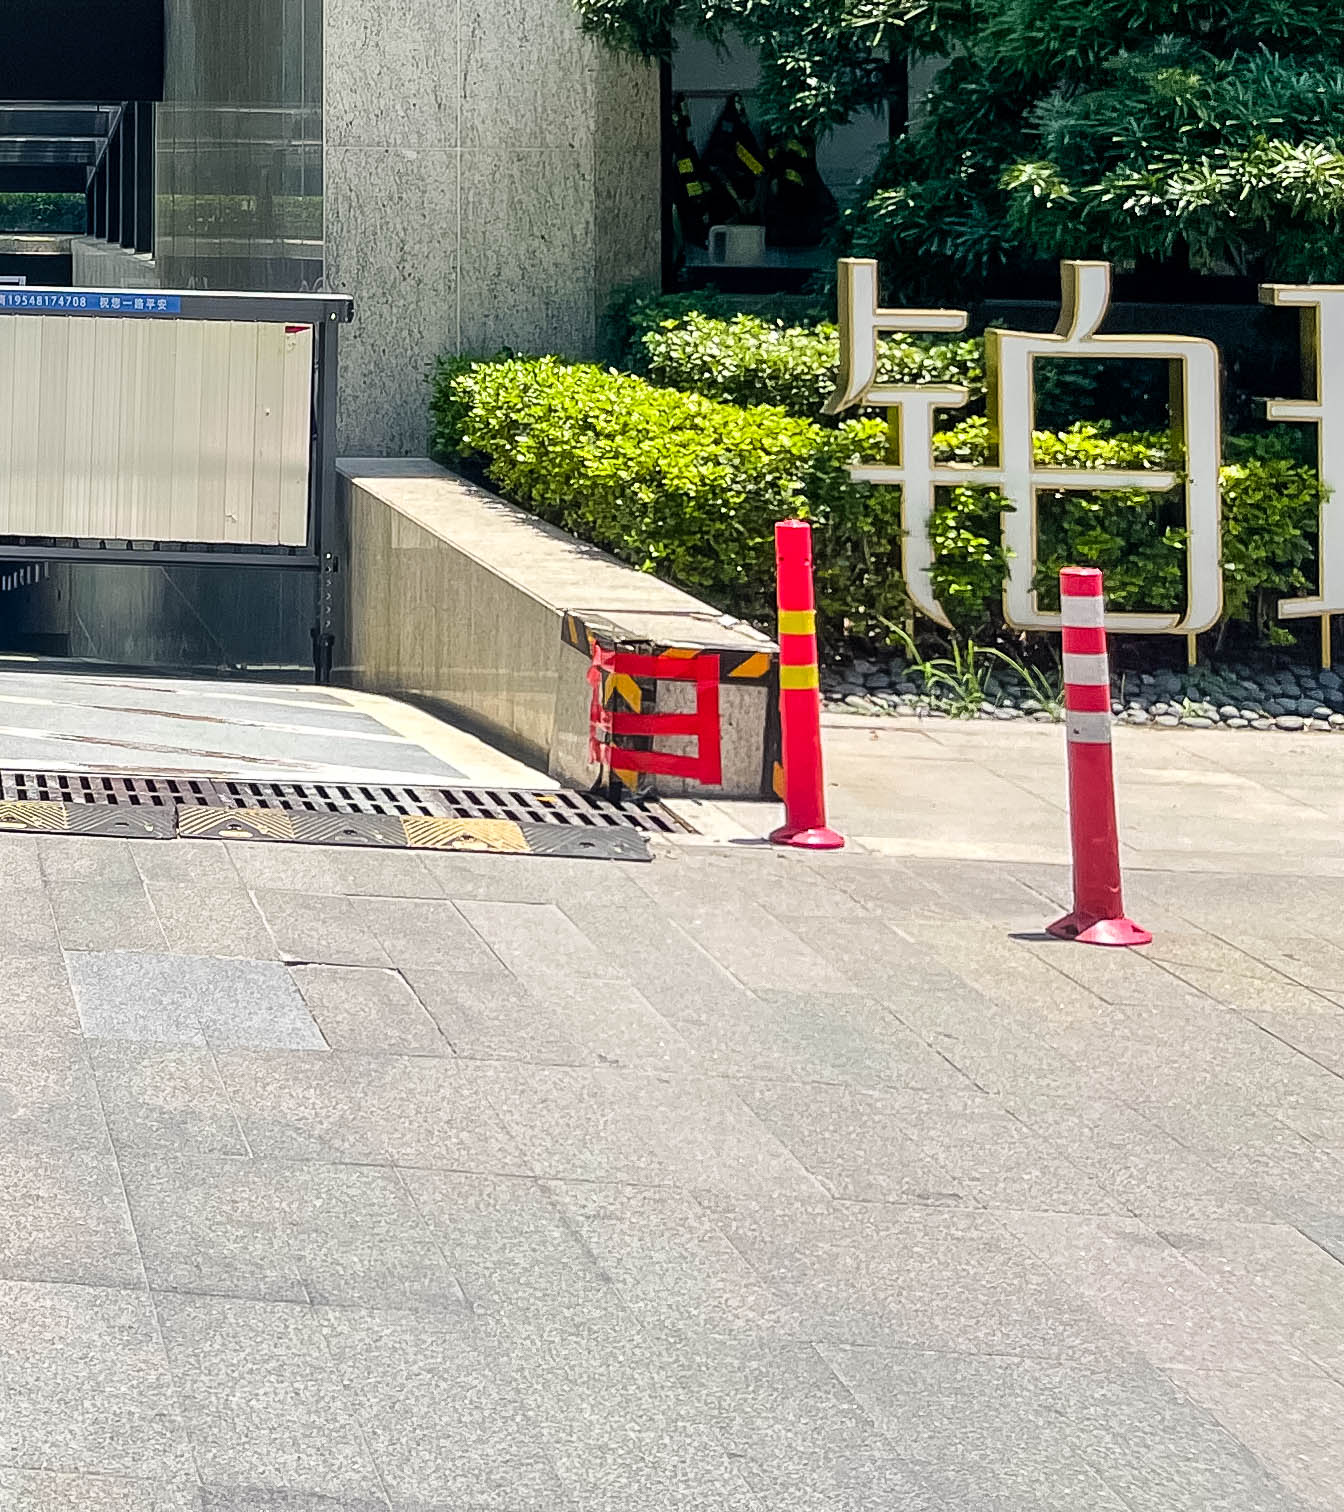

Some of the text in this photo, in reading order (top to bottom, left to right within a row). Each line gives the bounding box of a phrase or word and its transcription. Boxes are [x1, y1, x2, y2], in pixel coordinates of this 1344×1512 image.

[99, 296, 168, 311] 祝您一路平安
